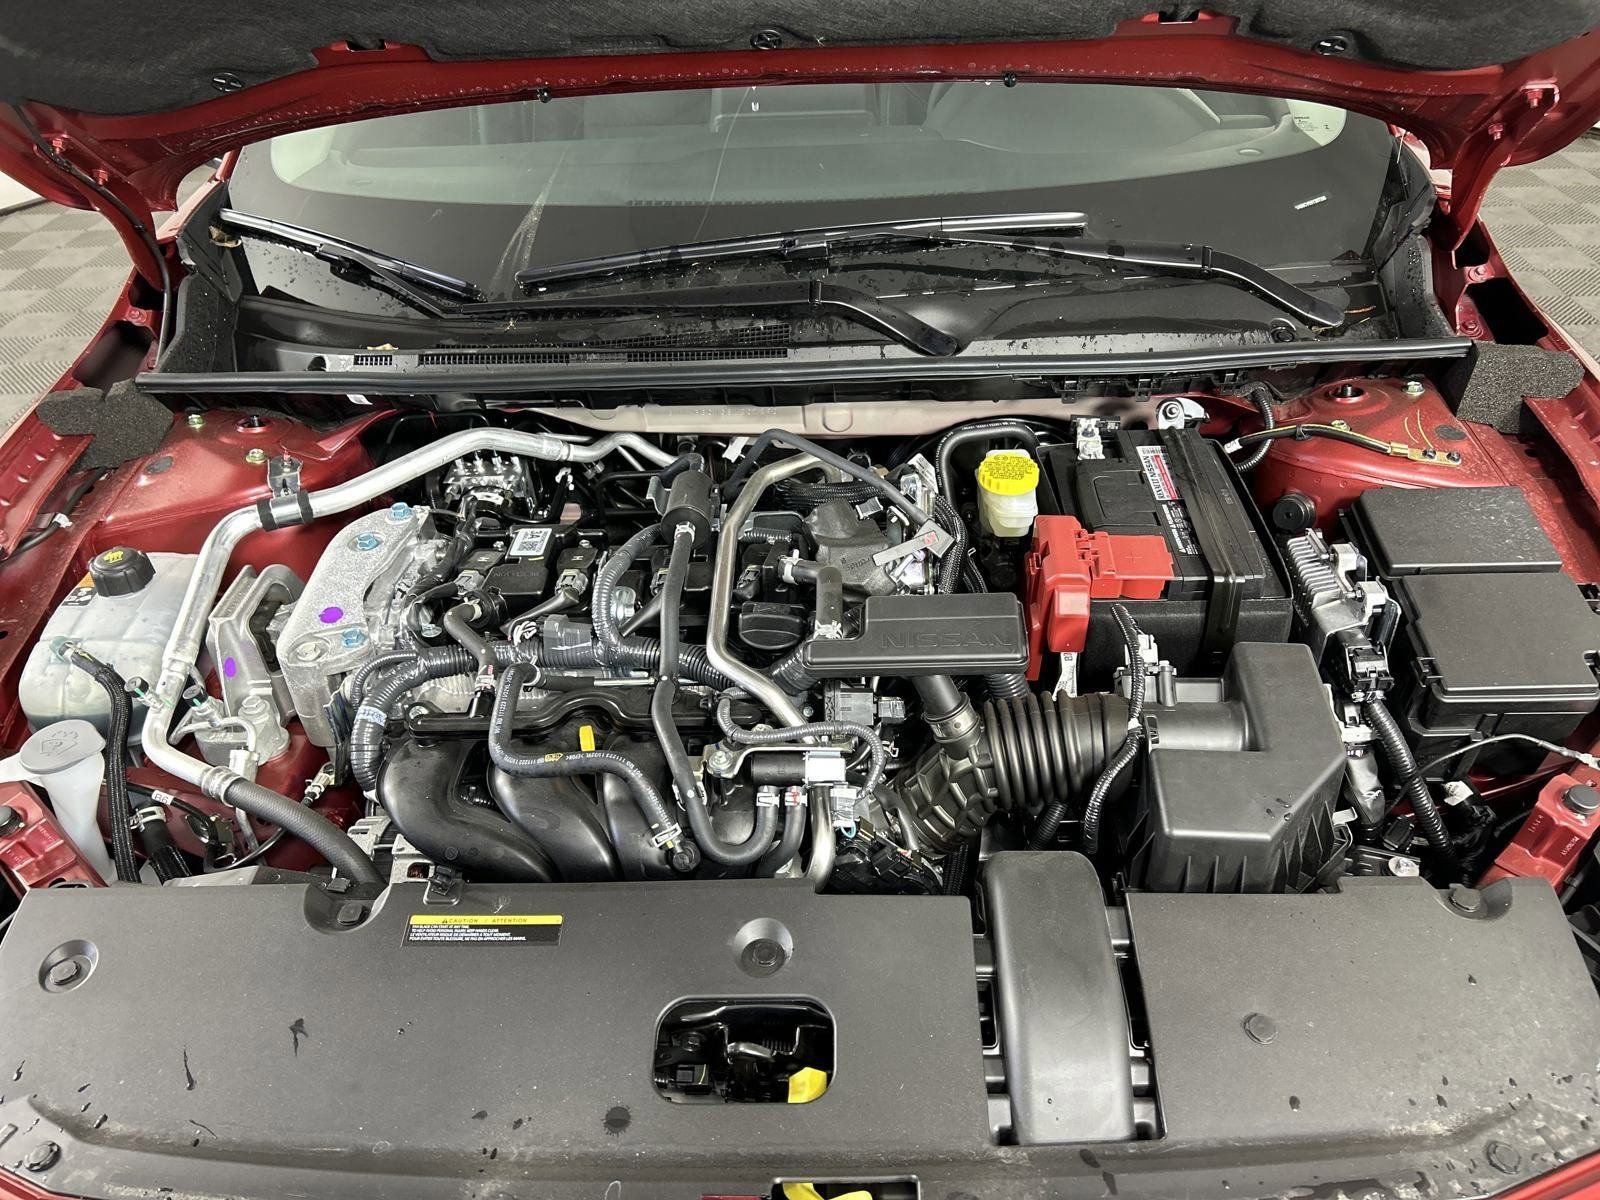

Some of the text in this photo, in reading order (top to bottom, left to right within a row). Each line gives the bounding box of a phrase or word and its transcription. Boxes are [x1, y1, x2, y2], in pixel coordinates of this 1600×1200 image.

[1143, 455, 1156, 477] NISSAN
[1151, 477, 1166, 500] RENAULT
[881, 631, 1014, 649] NISSAN
